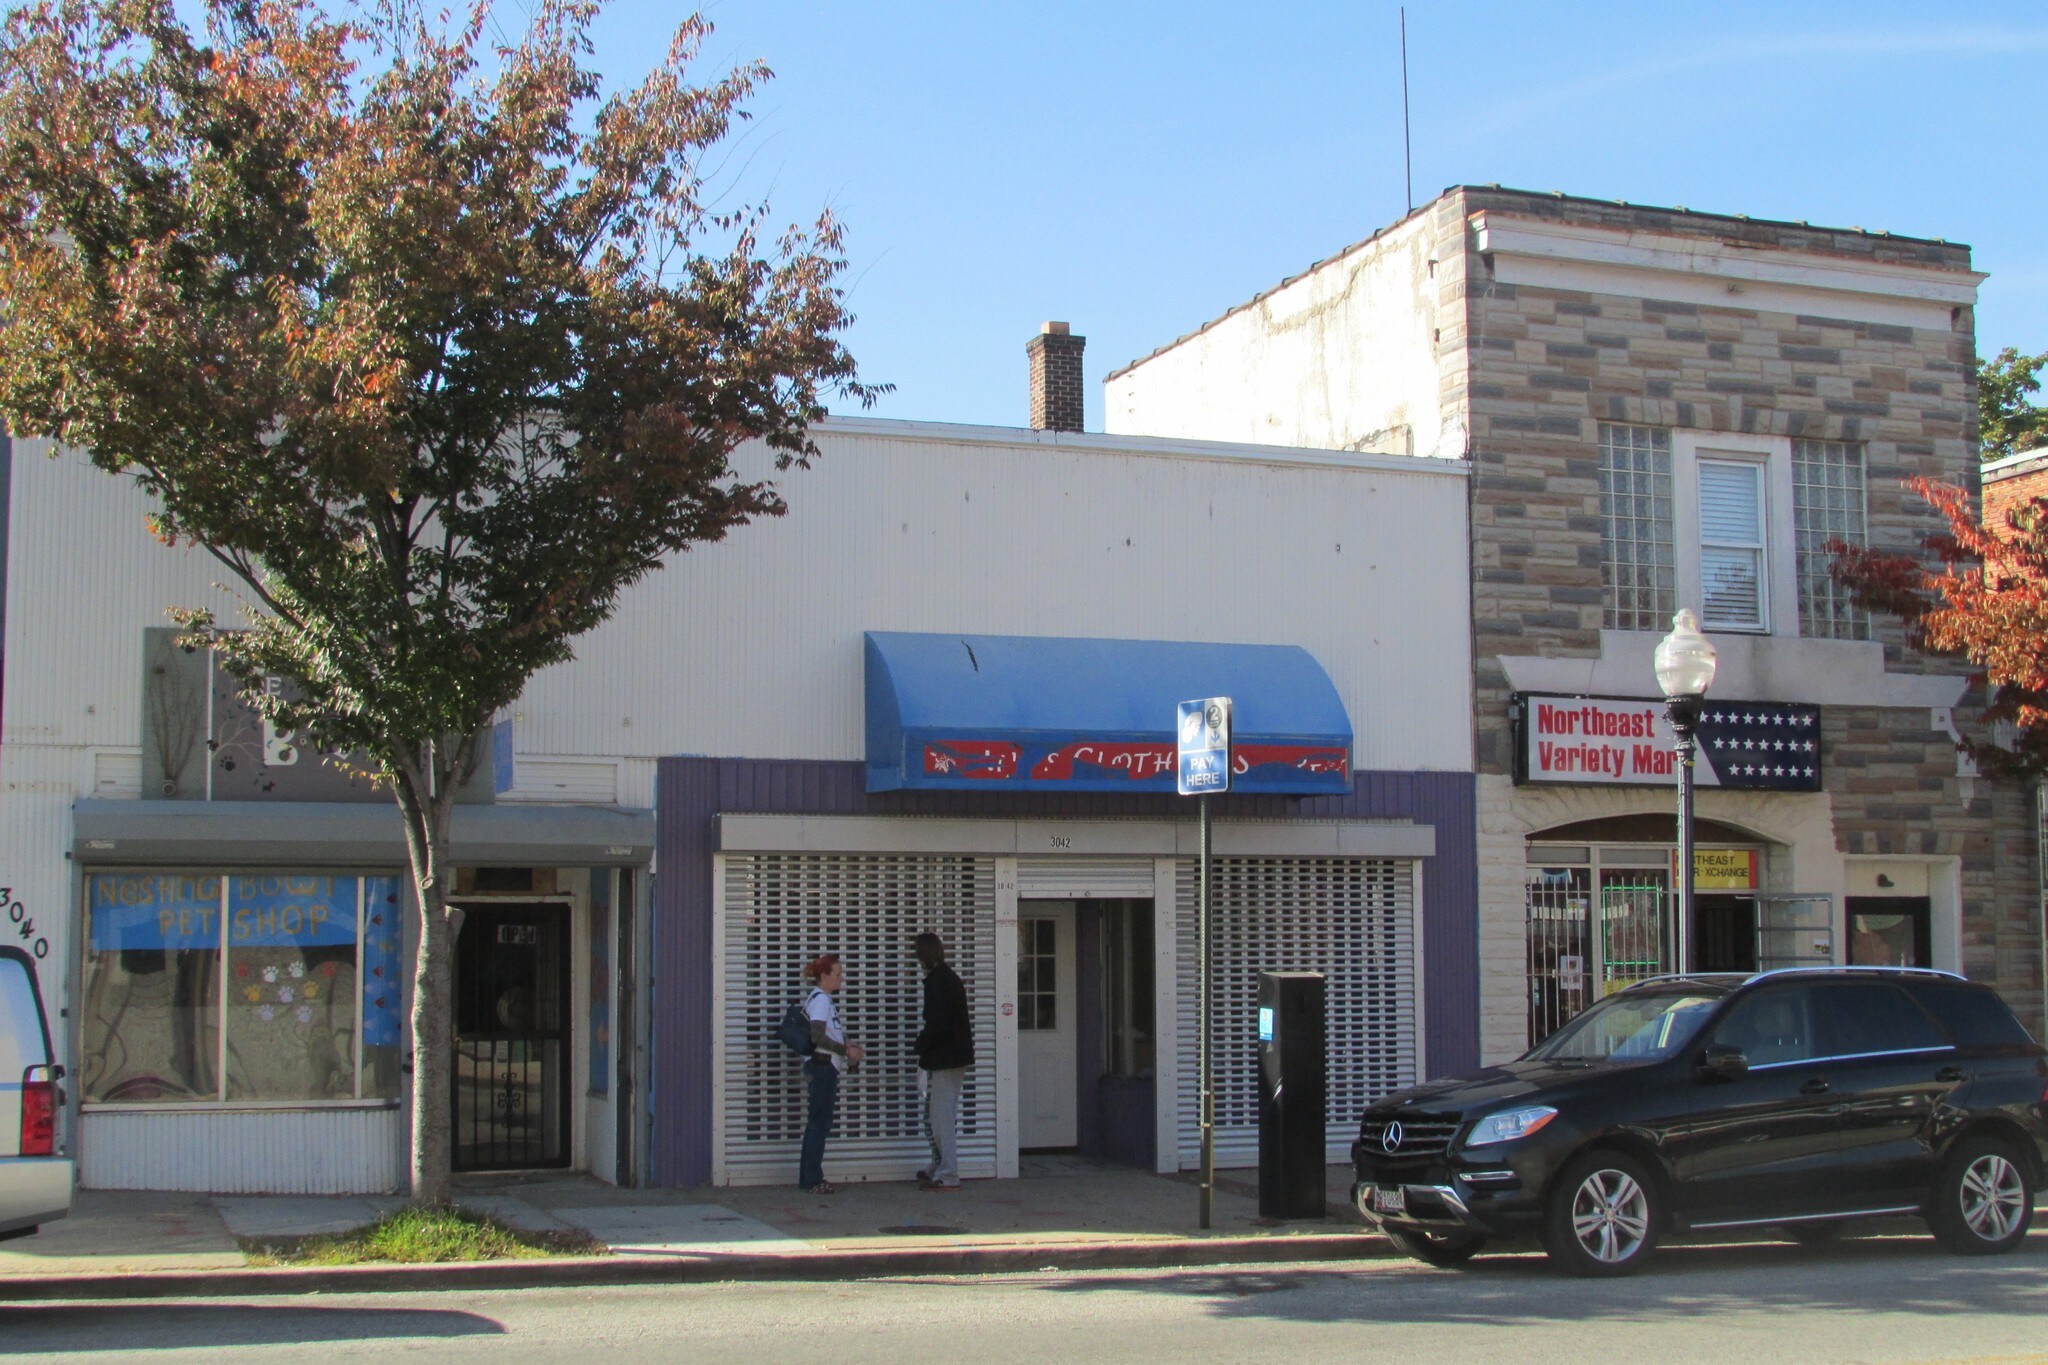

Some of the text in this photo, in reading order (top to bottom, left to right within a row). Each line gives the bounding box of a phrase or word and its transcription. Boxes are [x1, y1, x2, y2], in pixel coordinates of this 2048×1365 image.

[1209, 705, 1220, 720] 2
[1538, 704, 1655, 738] Northeast
[1190, 756, 1215, 770] PAY
[1538, 741, 1678, 778] Variety Mar
[1186, 772, 1220, 787] HERE
[1050, 836, 1071, 849] 3042
[0, 888, 48, 959] 3040
[159, 904, 330, 941] PET SHOP
